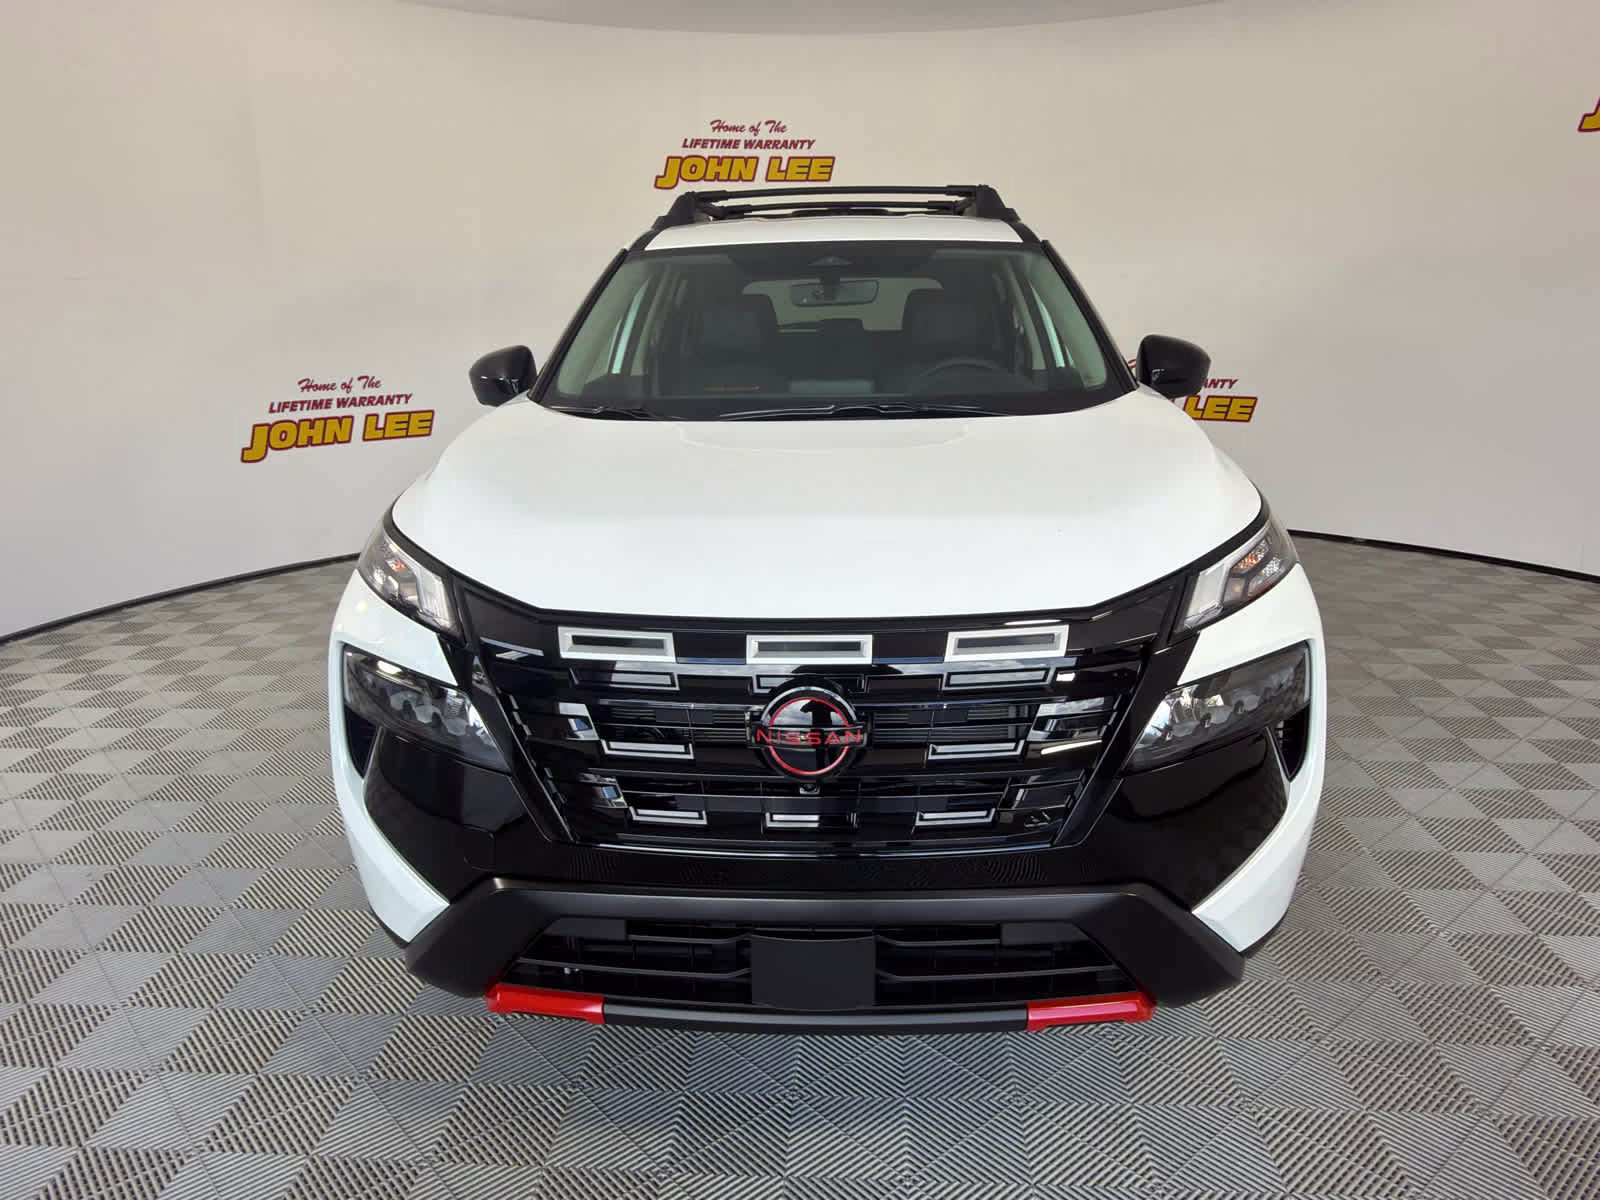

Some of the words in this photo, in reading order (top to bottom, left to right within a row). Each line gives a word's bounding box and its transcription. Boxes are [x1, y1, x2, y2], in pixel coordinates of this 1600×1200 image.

[710, 119, 745, 133] Home
[749, 121, 761, 136] of
[764, 119, 787, 133] The
[682, 138, 741, 149] LIFETIME
[743, 139, 816, 150] WARRANTY
[654, 155, 759, 190] JOHN
[765, 156, 836, 182] LEE
[297, 378, 337, 393] Home
[340, 378, 354, 393] of
[357, 375, 381, 389] The
[268, 398, 333, 414] LIFETIME
[336, 393, 412, 408] WARRANTY
[1182, 395, 1258, 422] LEE
[240, 415, 354, 464] JOHN
[362, 409, 434, 441] LEE
[756, 729, 861, 745] NISSAN
